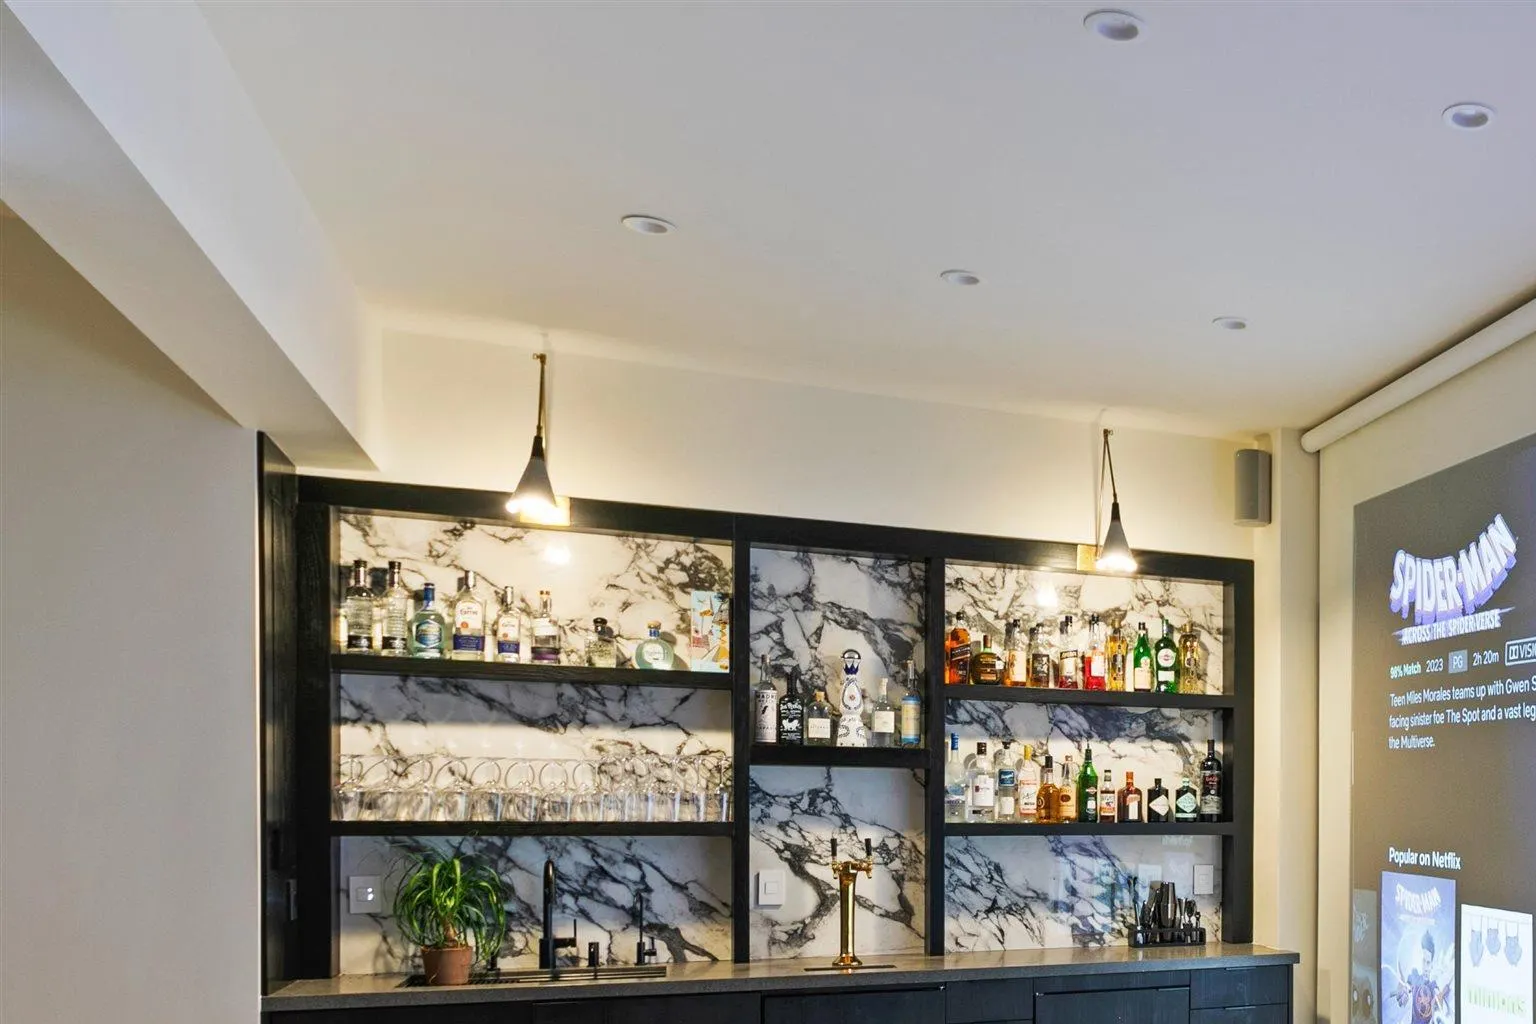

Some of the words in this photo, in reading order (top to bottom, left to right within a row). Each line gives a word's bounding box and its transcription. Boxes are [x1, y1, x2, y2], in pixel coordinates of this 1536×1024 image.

[1389, 513, 1517, 625] SPIDER-MAN
[1403, 662, 1421, 676] Match
[1426, 658, 1444, 672] 2023
[1452, 655, 1464, 669] PG
[1472, 651, 1482, 666] 2h
[1483, 650, 1500, 665] 20m
[1390, 694, 1406, 707] Teen
[1406, 691, 1422, 705] Miles
[1423, 687, 1451, 702] Morales
[1452, 687, 1475, 700] teams
[1476, 687, 1486, 700] up
[1488, 680, 1504, 696] with
[1506, 678, 1529, 694] Gwen
[1389, 715, 1409, 731] facing
[1410, 713, 1432, 727] sinister
[1433, 710, 1444, 724] foe
[1446, 709, 1460, 723] The
[1462, 708, 1480, 725] Spot
[1481, 705, 1496, 721] and
[1497, 708, 1503, 720] a
[1504, 703, 1522, 719] vast
[1388, 737, 1399, 749] the
[1389, 847, 1418, 867] Popular
[1419, 853, 1430, 866] on
[1432, 851, 1461, 870] Netflix
